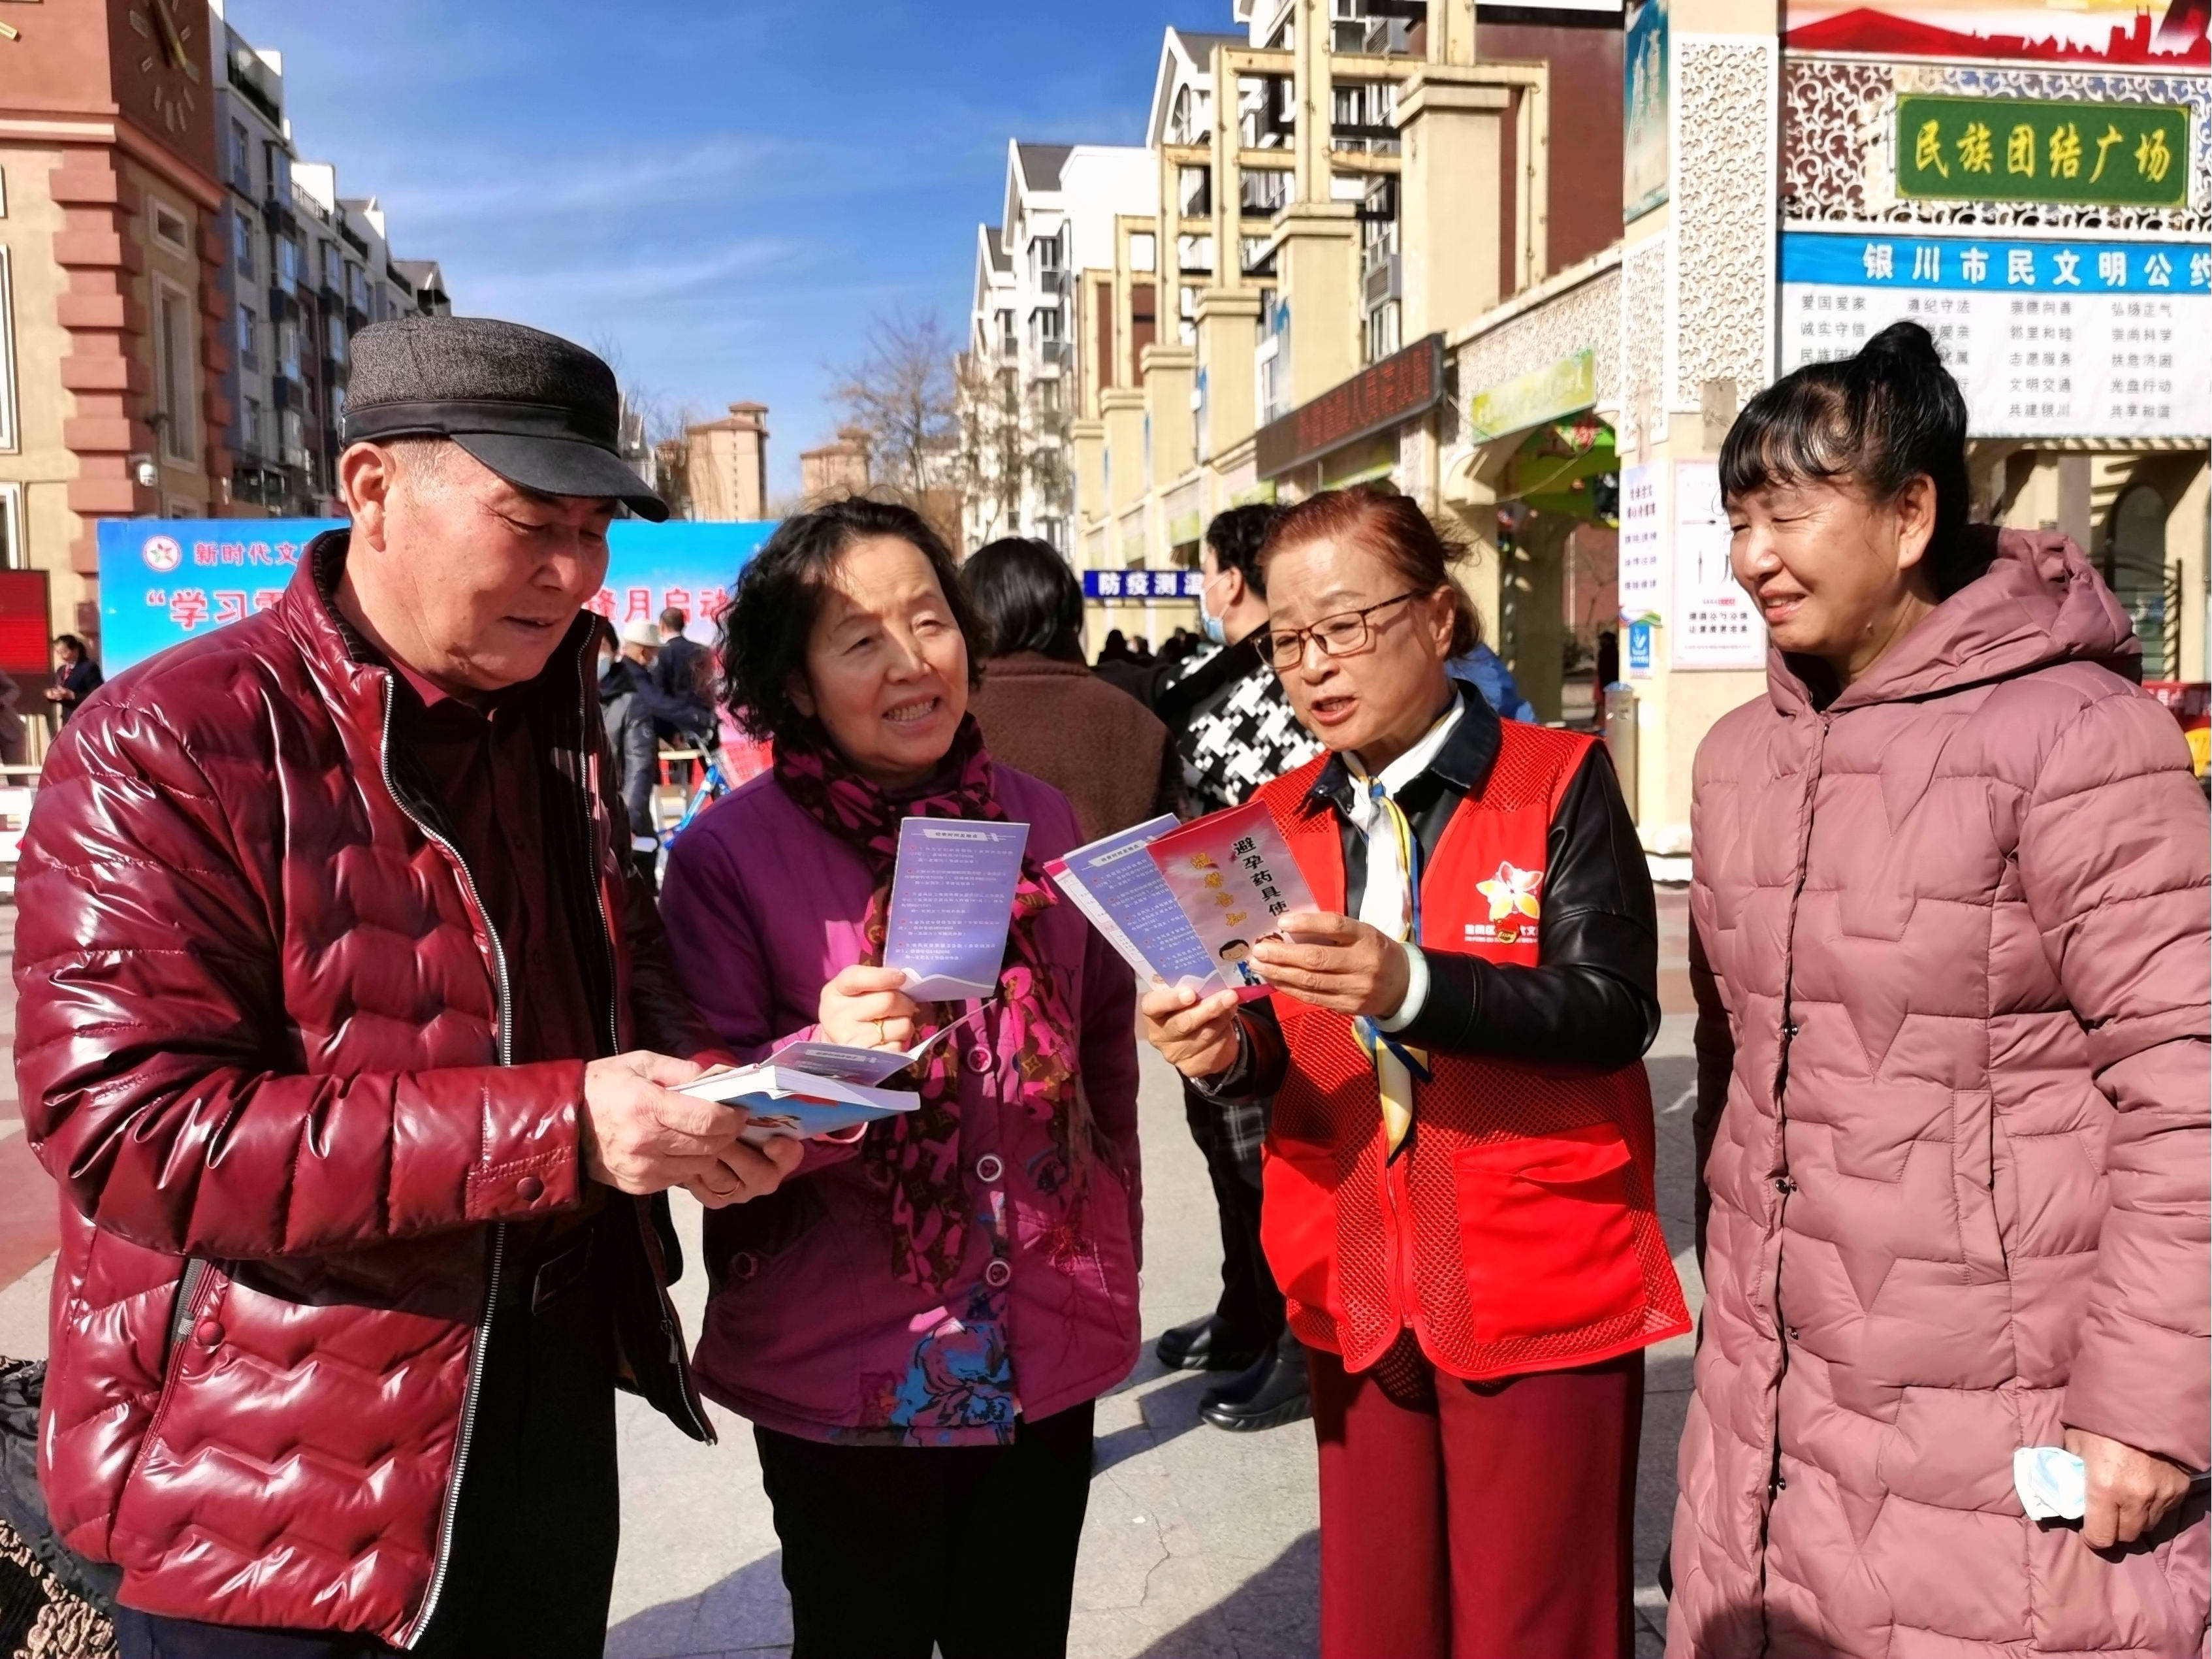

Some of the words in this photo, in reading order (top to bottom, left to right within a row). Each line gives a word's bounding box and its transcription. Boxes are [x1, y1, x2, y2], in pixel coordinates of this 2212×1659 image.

[1914, 120, 2172, 184] 民族团结广场
[1863, 243, 2211, 289] 银川市民文明公约
[1801, 295, 1865, 311] 爱国爱家
[1908, 298, 1970, 314] 遵纪守法
[2111, 302, 2172, 317] 弘扬正气
[1801, 322, 1865, 337] 诚实守信
[1801, 347, 1857, 364] 民族团
[2010, 351, 2070, 366] 志愿服务
[2010, 378, 2070, 392] 文明交通
[2111, 378, 2172, 394] 光盘行动
[195, 543, 303, 566] 新时代文
[1233, 837, 1290, 917] 避孕药具使
